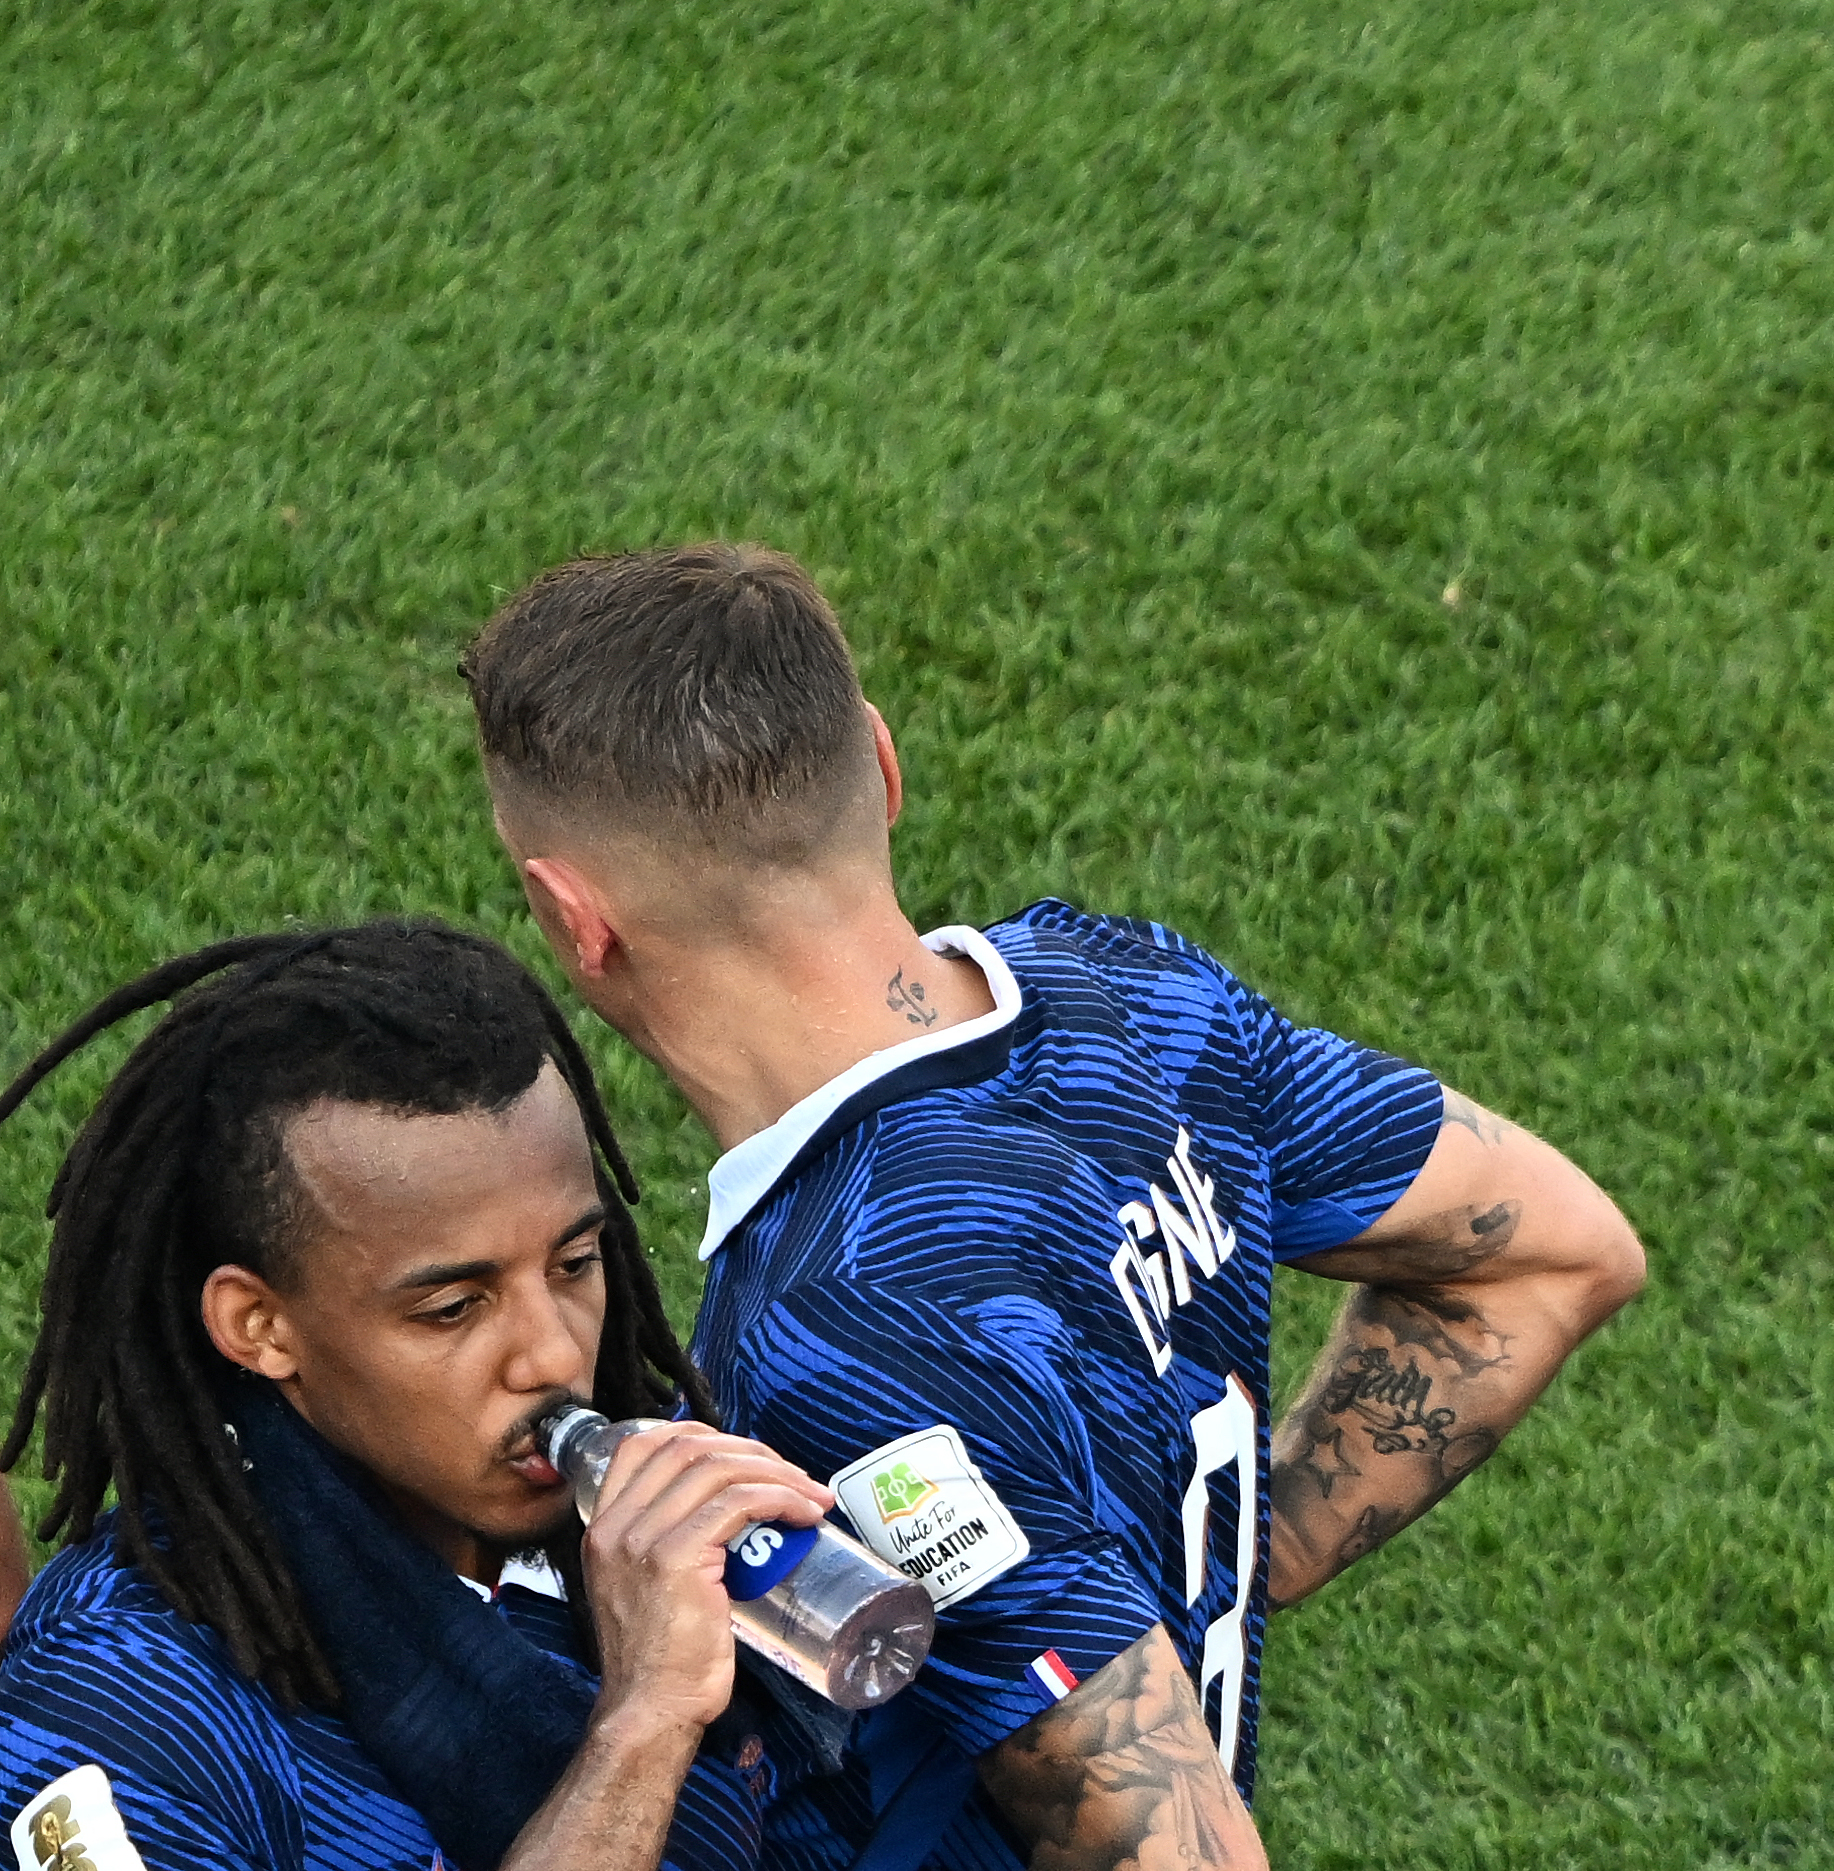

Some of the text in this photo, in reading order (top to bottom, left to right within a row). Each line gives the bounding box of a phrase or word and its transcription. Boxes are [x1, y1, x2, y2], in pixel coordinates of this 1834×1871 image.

[1109, 1124, 1237, 1378] DGNE
[889, 1501, 958, 1555] Unite For
[898, 1517, 989, 1580] EDUCATION
[936, 1562, 972, 1587] FIFA
